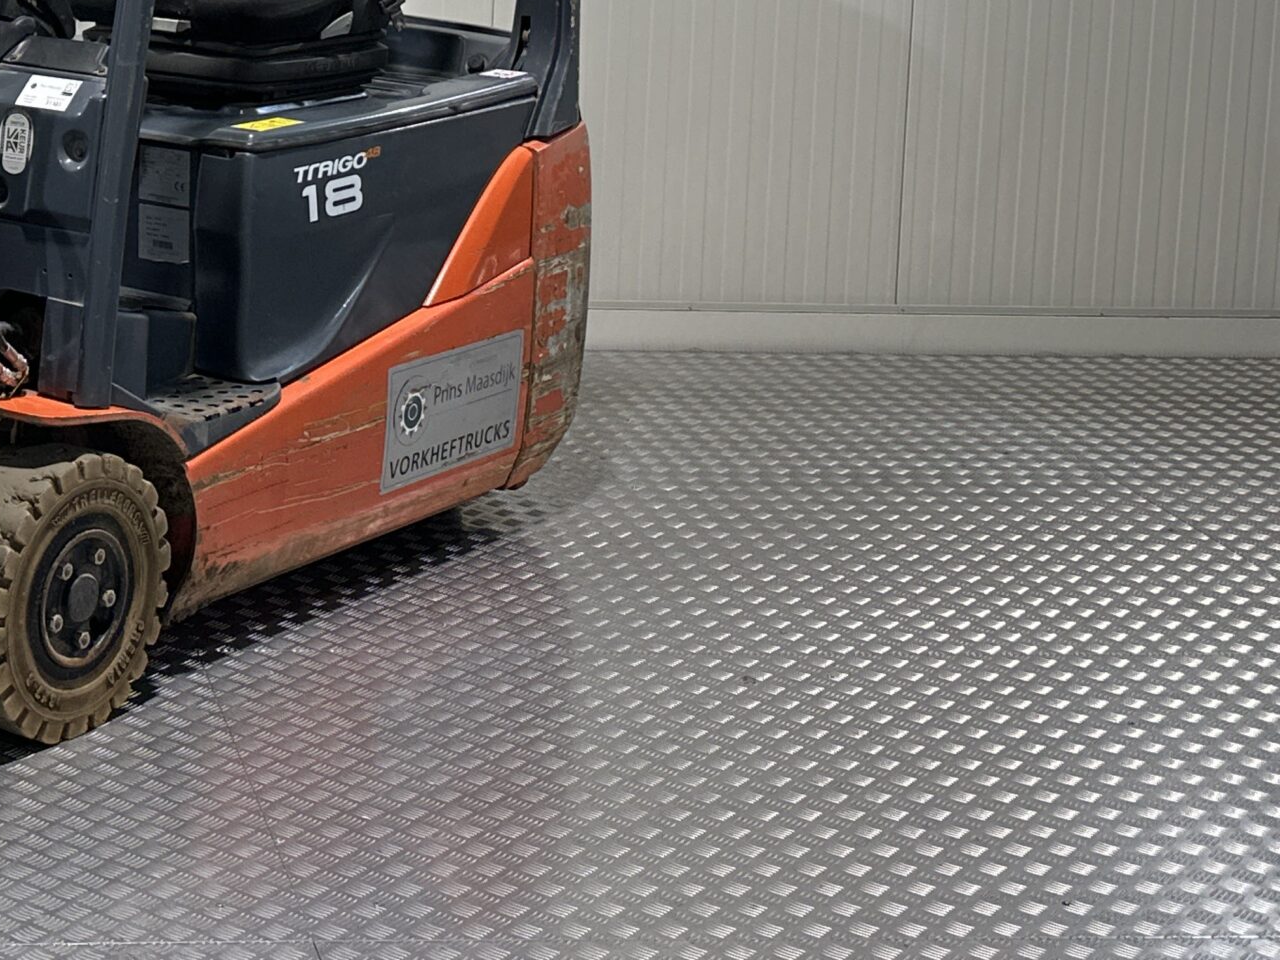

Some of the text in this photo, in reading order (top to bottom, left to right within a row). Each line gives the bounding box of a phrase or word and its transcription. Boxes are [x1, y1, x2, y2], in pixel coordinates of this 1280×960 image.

[301, 174, 364, 223] 18
[433, 363, 516, 406] Prins Maasdijk
[389, 419, 511, 480] VORKHEFTRUCKS
